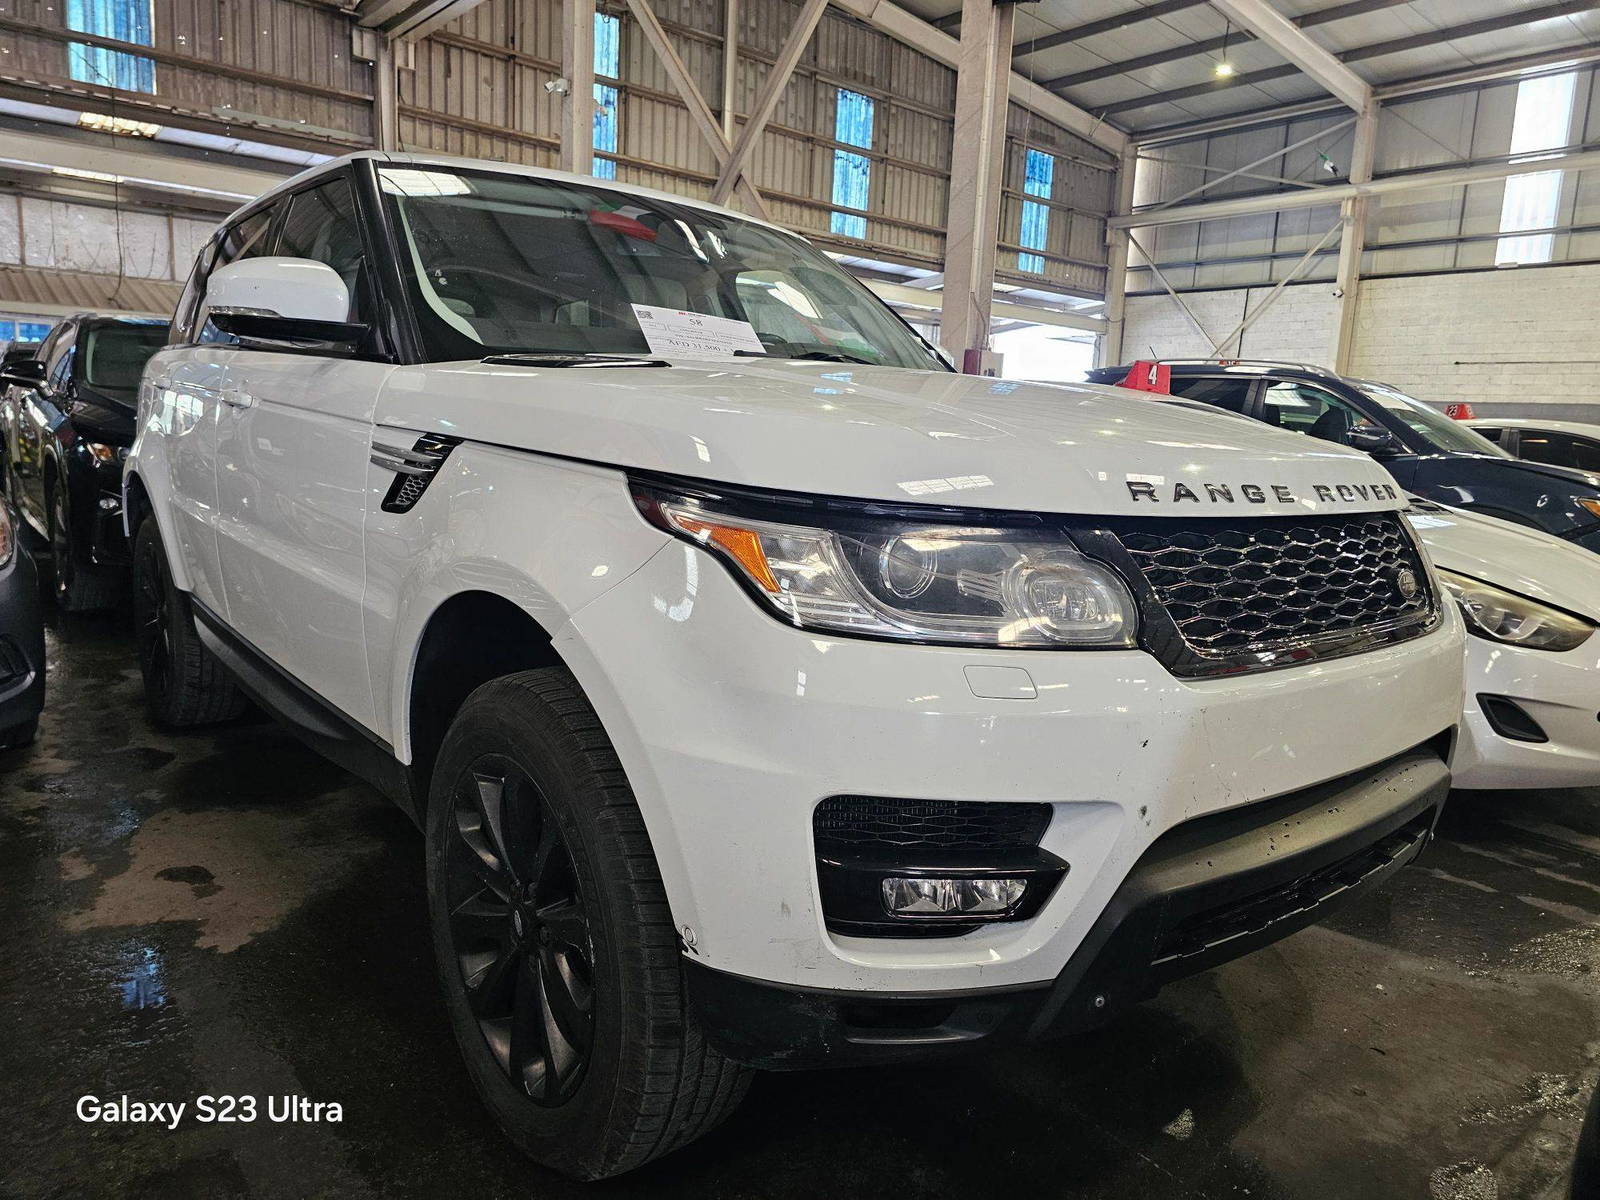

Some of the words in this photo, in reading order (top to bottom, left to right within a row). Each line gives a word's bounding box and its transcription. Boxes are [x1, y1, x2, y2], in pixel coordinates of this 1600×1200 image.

[1148, 365, 1158, 385] 4
[1126, 481, 1296, 503] RANGE
[1312, 483, 1398, 502] ROVER
